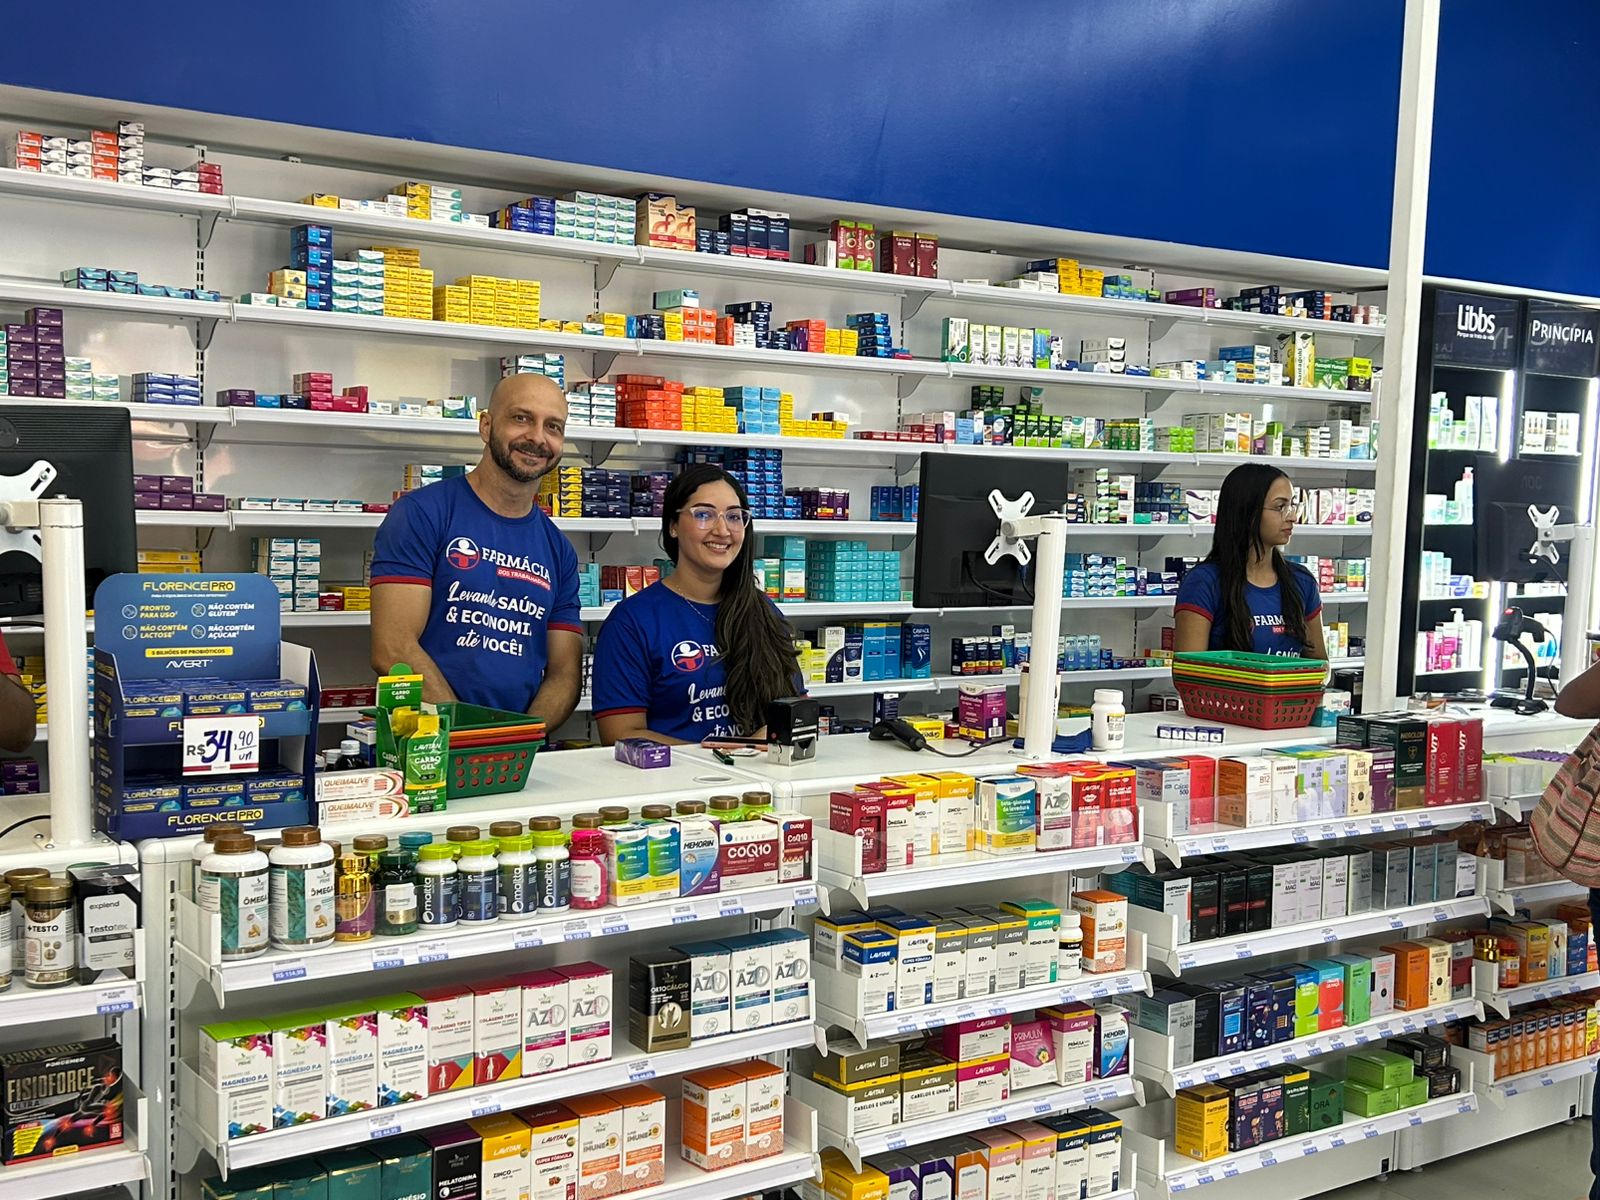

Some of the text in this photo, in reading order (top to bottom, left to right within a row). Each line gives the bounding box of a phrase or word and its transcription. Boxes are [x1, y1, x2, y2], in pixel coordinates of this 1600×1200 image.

[1457, 304, 1496, 333] Libbs
[482, 547, 552, 583] FARMÁCIA
[143, 581, 234, 591] FLORENCE PRO
[498, 596, 546, 620] SAÚDE
[446, 606, 532, 636] & ECONOMI
[1254, 615, 1285, 626] FARM
[456, 629, 523, 656] até VOCÊ!
[166, 659, 211, 668] AVERT
[688, 683, 726, 704] Levan
[692, 707, 702, 722] &
[187, 745, 206, 756] R$
[414, 756, 440, 765] CARBO
[421, 763, 436, 771] GEL
[168, 810, 261, 826] FLORENCE PRO
[683, 839, 715, 850] MEMORIN
[908, 938, 929, 946] LAVITAN
[869, 951, 891, 959] LAVITAN
[855, 1061, 876, 1071] LAVITAN
[975, 1066, 996, 1075] LAVITAN
[7, 1066, 95, 1103] FISIOFORCE
[921, 1077, 942, 1085] LAVITAN
[864, 1088, 885, 1098] LAVITAN
[1313, 1100, 1330, 1110] ORA
[541, 1133, 568, 1144] LAVITAN
[493, 1144, 522, 1156] LAVITAN
[438, 1173, 477, 1186] MELATONINA
